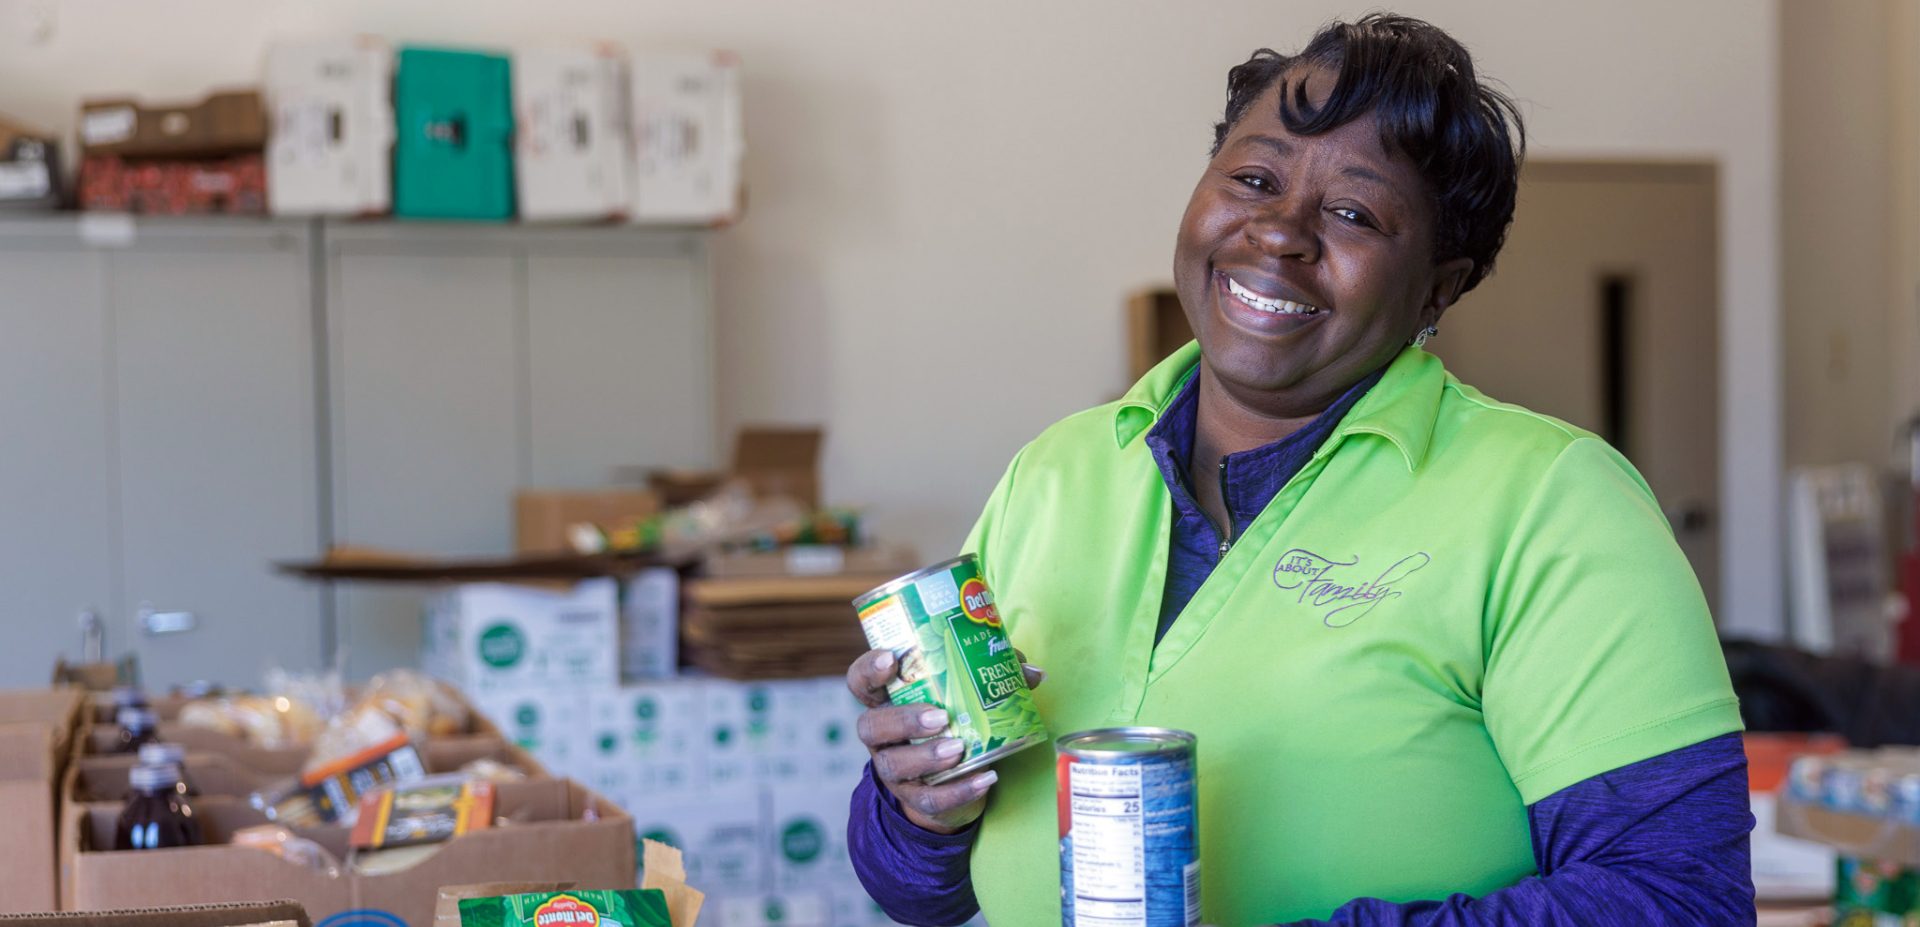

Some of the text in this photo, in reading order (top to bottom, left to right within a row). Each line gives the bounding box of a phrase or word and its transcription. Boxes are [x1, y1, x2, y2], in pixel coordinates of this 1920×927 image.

[1290, 555, 1313, 567] IT'S
[1277, 563, 1320, 576] ABOUT
[1296, 552, 1430, 628] Family
[965, 592, 986, 611] Del
[963, 630, 992, 647] MADE
[1111, 767, 1139, 776] Facts
[1072, 801, 1106, 813] Calories
[1123, 801, 1140, 813] 25
[538, 911, 594, 925] Del Monte
